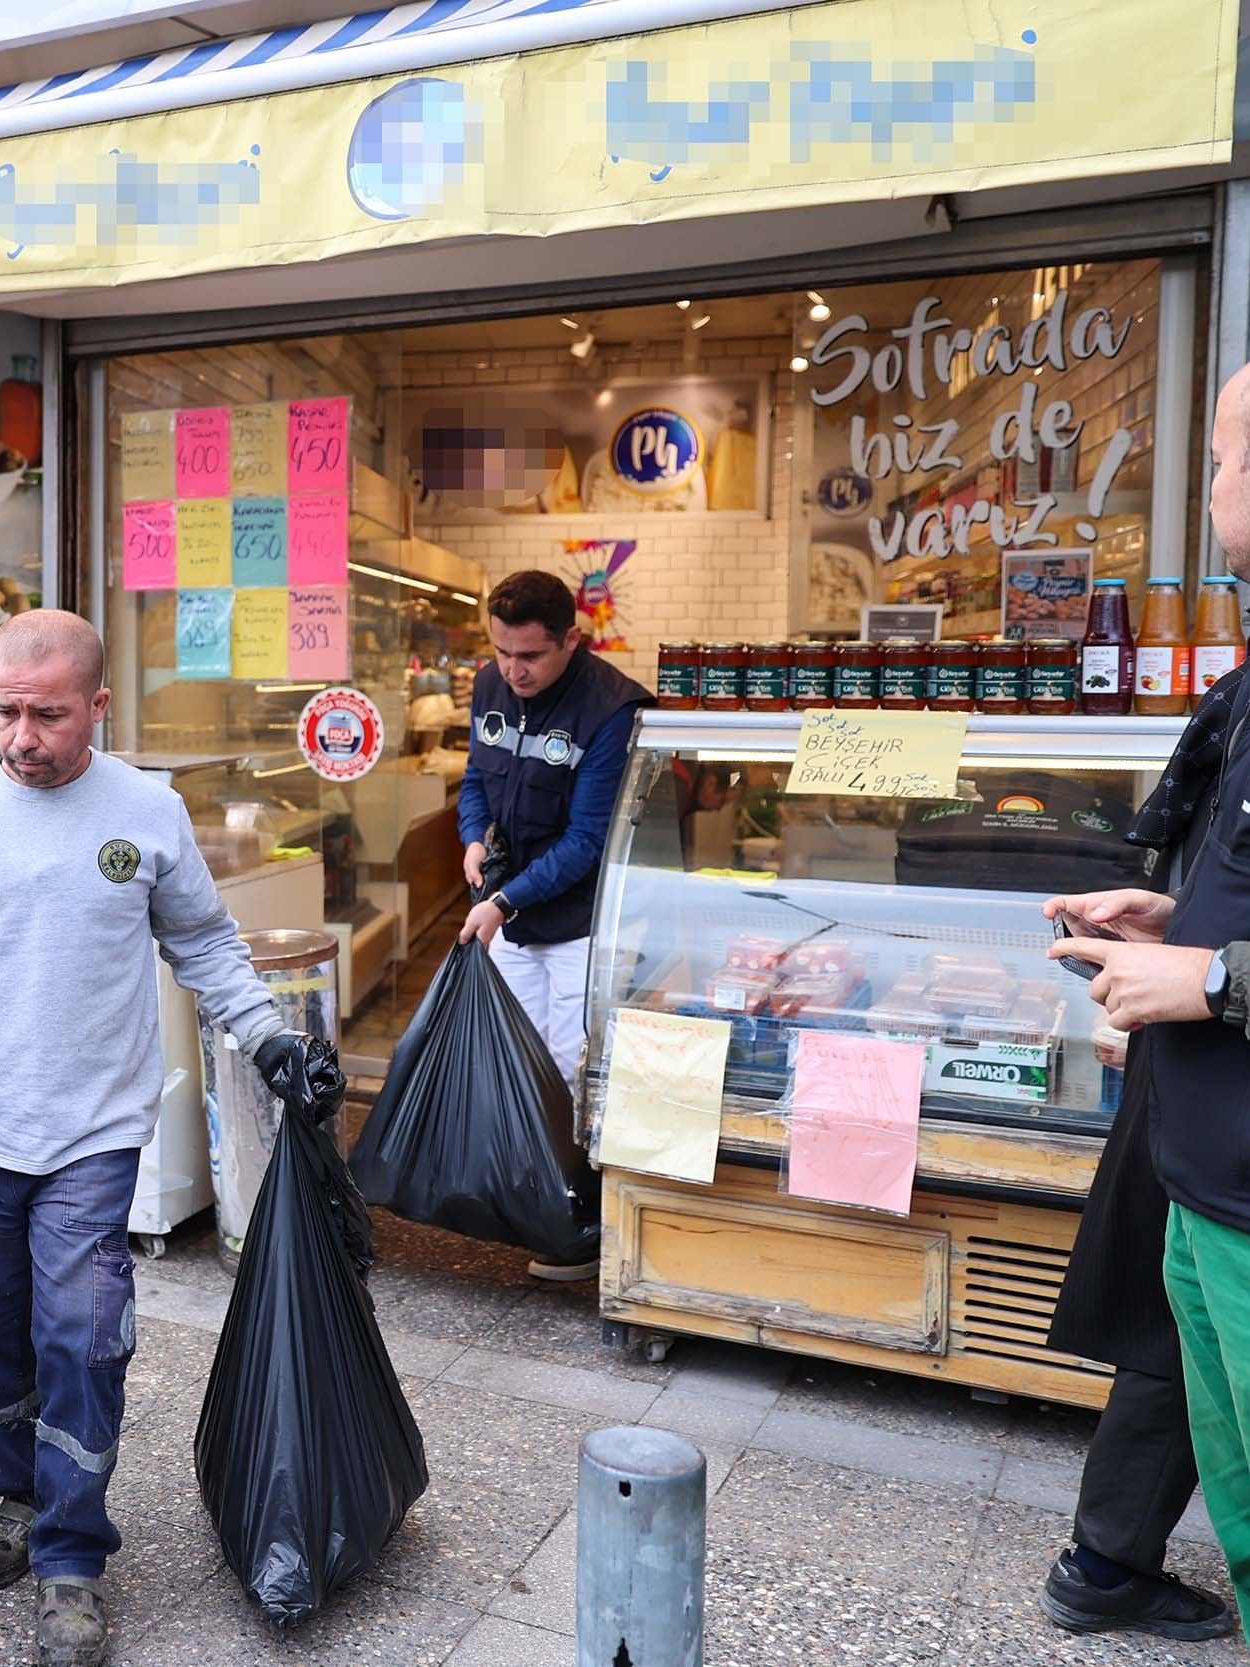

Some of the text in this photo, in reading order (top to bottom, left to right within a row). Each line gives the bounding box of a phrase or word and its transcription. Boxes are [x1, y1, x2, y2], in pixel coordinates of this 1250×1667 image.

[811, 288, 1133, 407] Sofrada
[850, 381, 1084, 479] biz de
[177, 445, 220, 475] 400
[291, 436, 341, 472] 450
[235, 533, 282, 560] 650
[291, 622, 329, 652] 389
